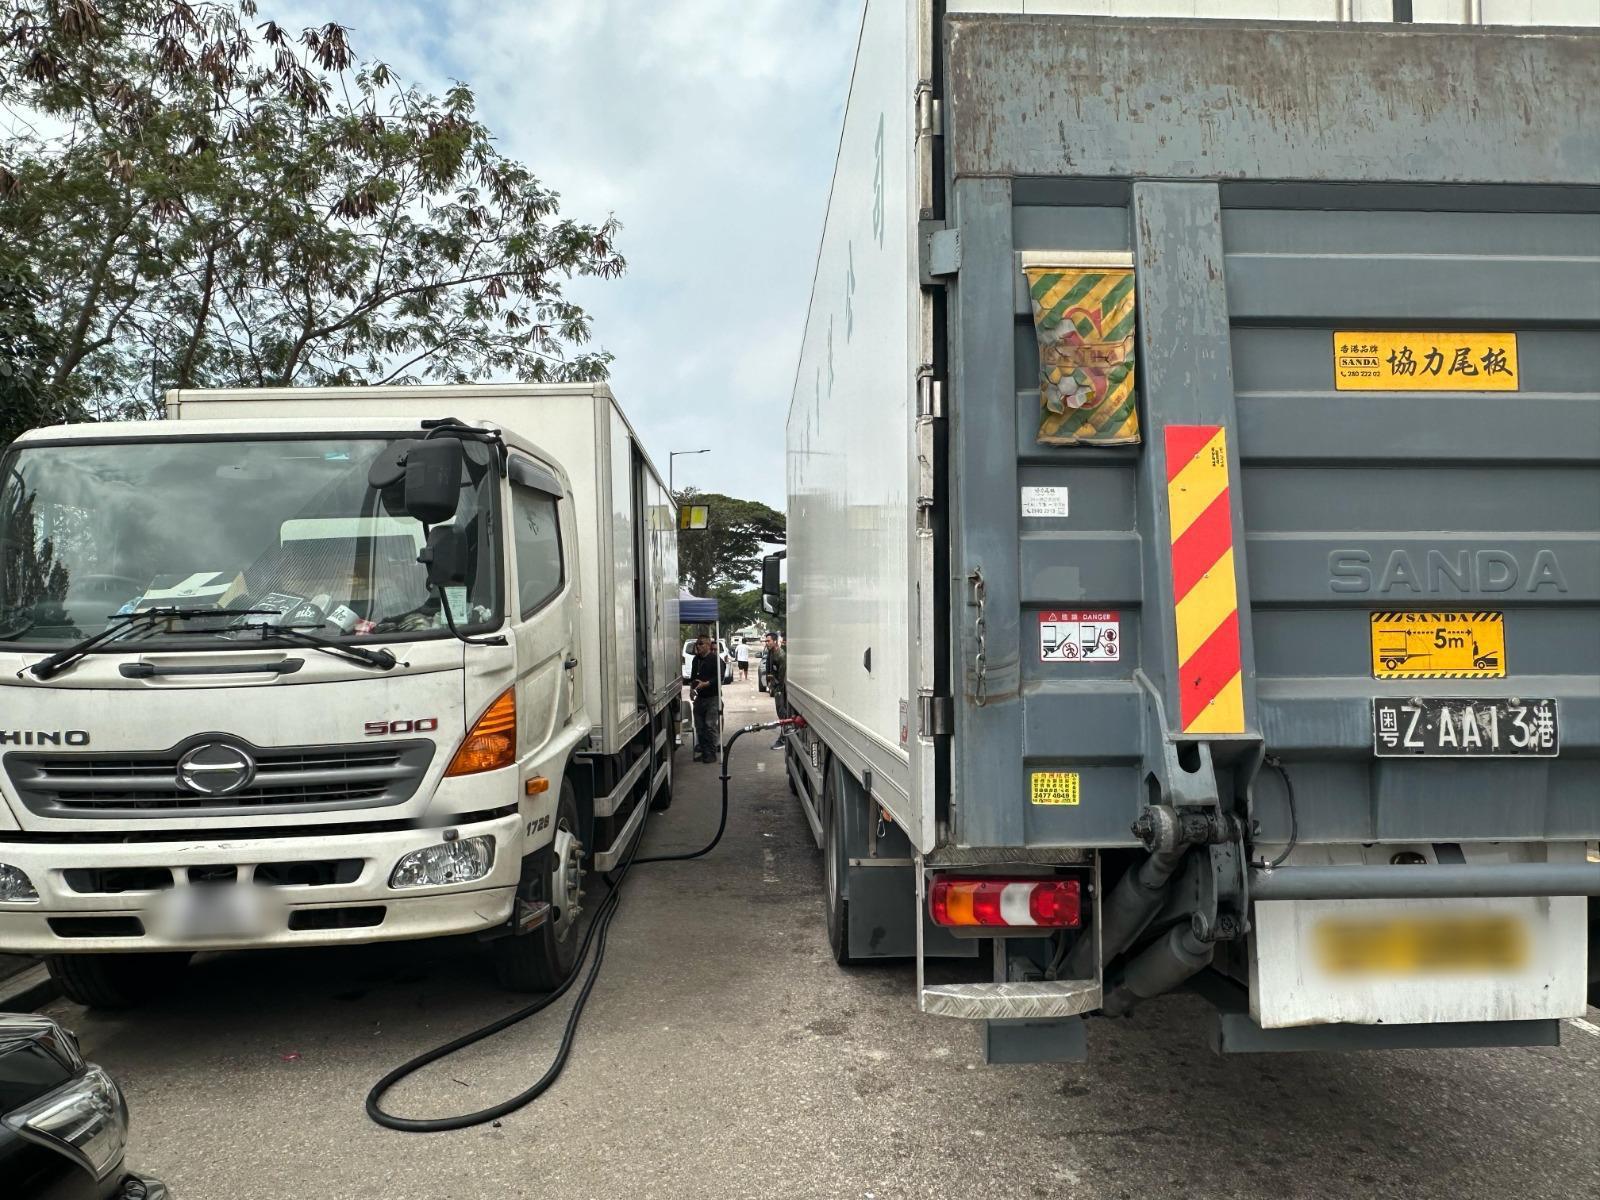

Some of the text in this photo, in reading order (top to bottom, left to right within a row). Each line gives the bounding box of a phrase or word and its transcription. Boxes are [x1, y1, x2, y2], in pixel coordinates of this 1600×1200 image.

[1341, 358, 1378, 366] SANDA
[1386, 345, 1513, 377] 協力尾板
[1328, 549, 1568, 593] SANDA
[1405, 613, 1469, 623] SANDA
[1433, 628, 1465, 649] 5m
[364, 718, 438, 736] 500
[0, 730, 90, 746] HINO
